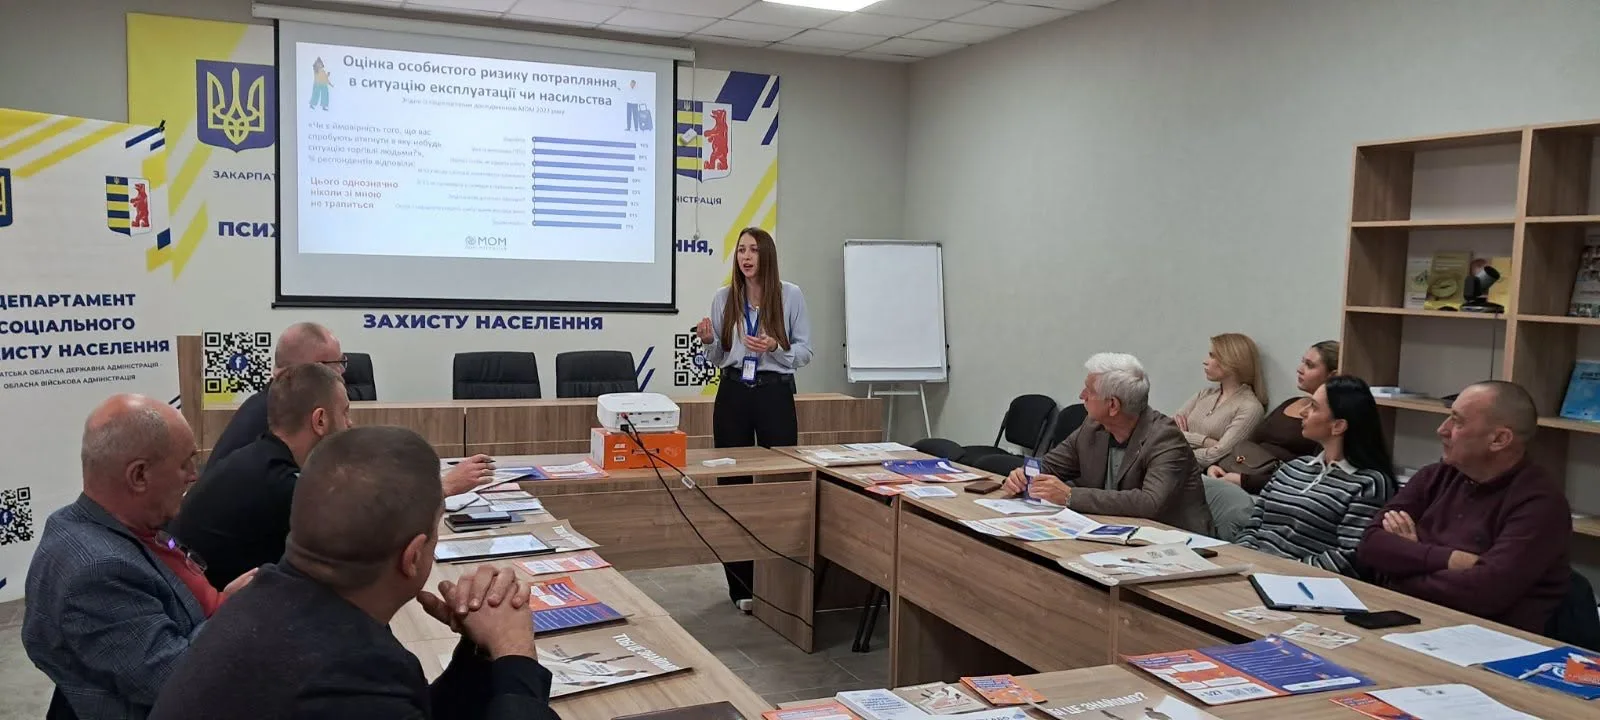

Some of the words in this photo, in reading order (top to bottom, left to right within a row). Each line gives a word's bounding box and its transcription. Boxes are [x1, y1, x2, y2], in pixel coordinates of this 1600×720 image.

[343, 54, 394, 70] Оцінка
[398, 62, 476, 76] особистого
[480, 68, 528, 81] ризику
[532, 72, 617, 88] потрапляння
[349, 77, 357, 86] в
[362, 78, 426, 92] ситуацію
[430, 82, 516, 100] експлуатації
[519, 91, 535, 100] чи
[540, 92, 612, 106] насильства
[332, 123, 381, 132] ймовірність
[404, 128, 416, 136] що
[308, 132, 352, 142] спробують
[308, 144, 344, 153] ситуацію
[347, 146, 378, 156] торгівлі
[317, 156, 372, 166] респондентів
[310, 177, 340, 186] Цього
[342, 179, 399, 189] однозначно
[310, 189, 342, 197] ніколи
[325, 201, 374, 210] трапиться
[478, 236, 507, 246] МОМ
[0, 318, 135, 335] СОЦІАЛЬНОГО
[363, 314, 469, 329] ЗАХИСТУ
[476, 315, 603, 330] НАСЕЛЕННЯ
[0, 344, 52, 360] ИСТУ
[59, 340, 170, 357] НАСЕЛЕННЯ
[66, 365, 105, 374] ДЕРЖАВНА
[107, 362, 159, 371] АДМІНІСТРАЦІЯ
[4, 380, 39, 389] ОБЛАСНА
[41, 378, 81, 386] ВІЙСЬКОВА
[83, 374, 136, 384] АДМІНІСТРАЦІЯ
